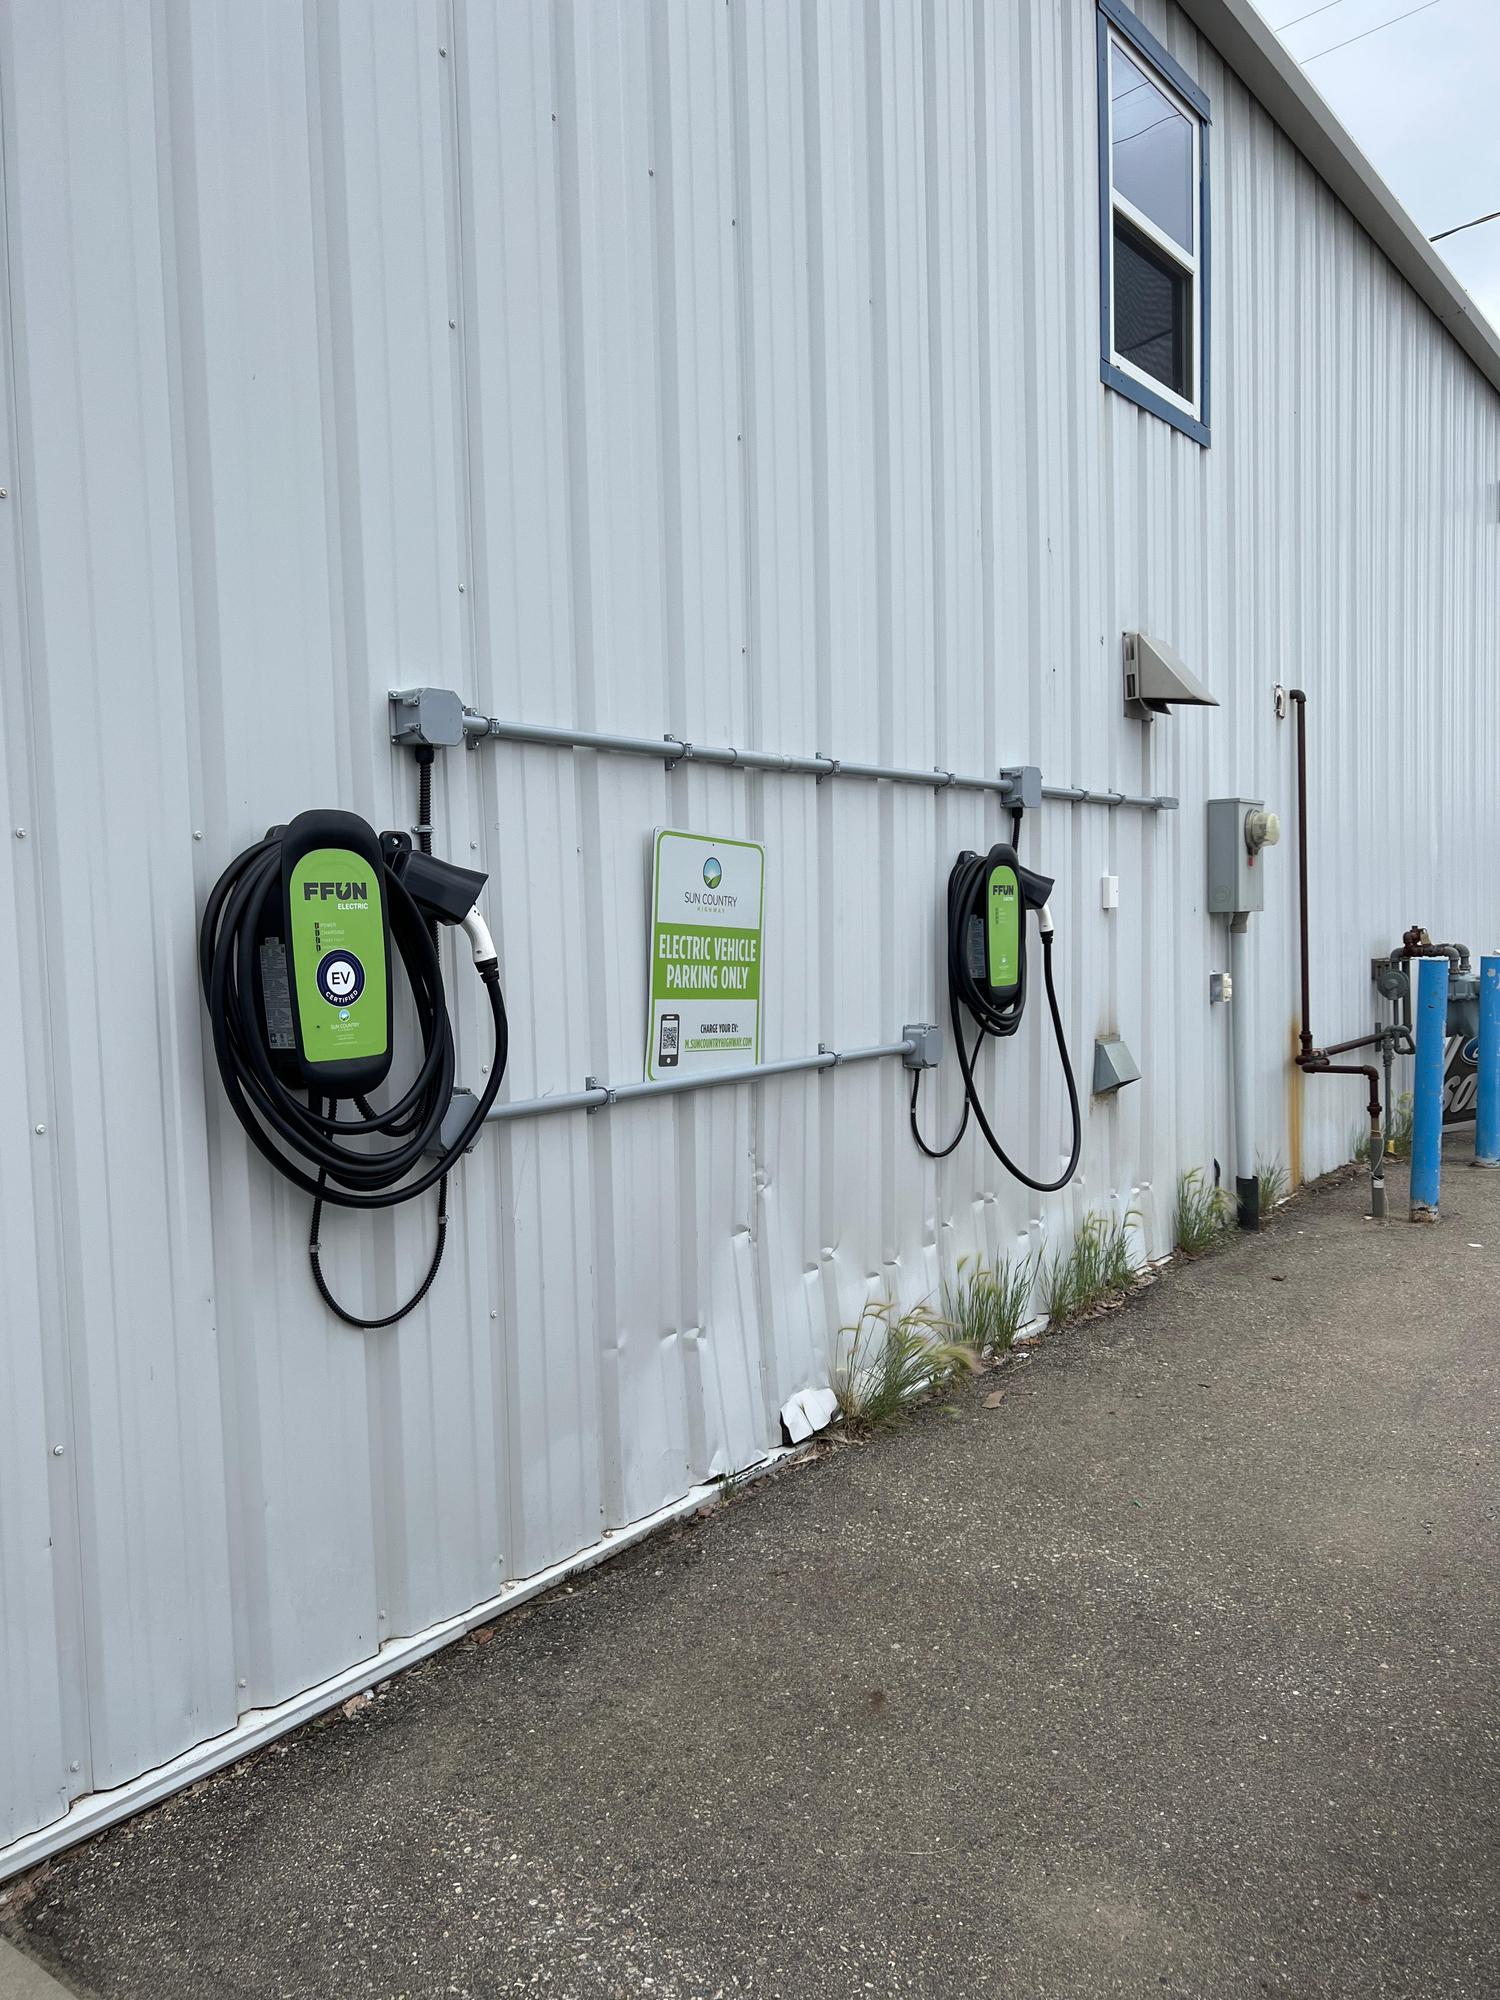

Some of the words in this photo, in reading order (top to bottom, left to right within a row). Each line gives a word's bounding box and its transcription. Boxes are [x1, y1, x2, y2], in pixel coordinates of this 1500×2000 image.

[303, 882, 368, 901] FFUN
[992, 884, 1014, 896] FFUN
[684, 891, 701, 904] SUN
[702, 893, 738, 907] COUNTRY
[658, 934, 711, 961] ELECTRIC
[714, 937, 757, 963] VEHICLE
[331, 971, 351, 985] EV
[666, 964, 719, 990] PARKING
[720, 966, 749, 990] ONLY
[325, 990, 358, 1003] CERTIFIED
[700, 1023, 718, 1034] CHARGE
[719, 1023, 731, 1033] YOUR
[731, 1023, 739, 1033] EV:
